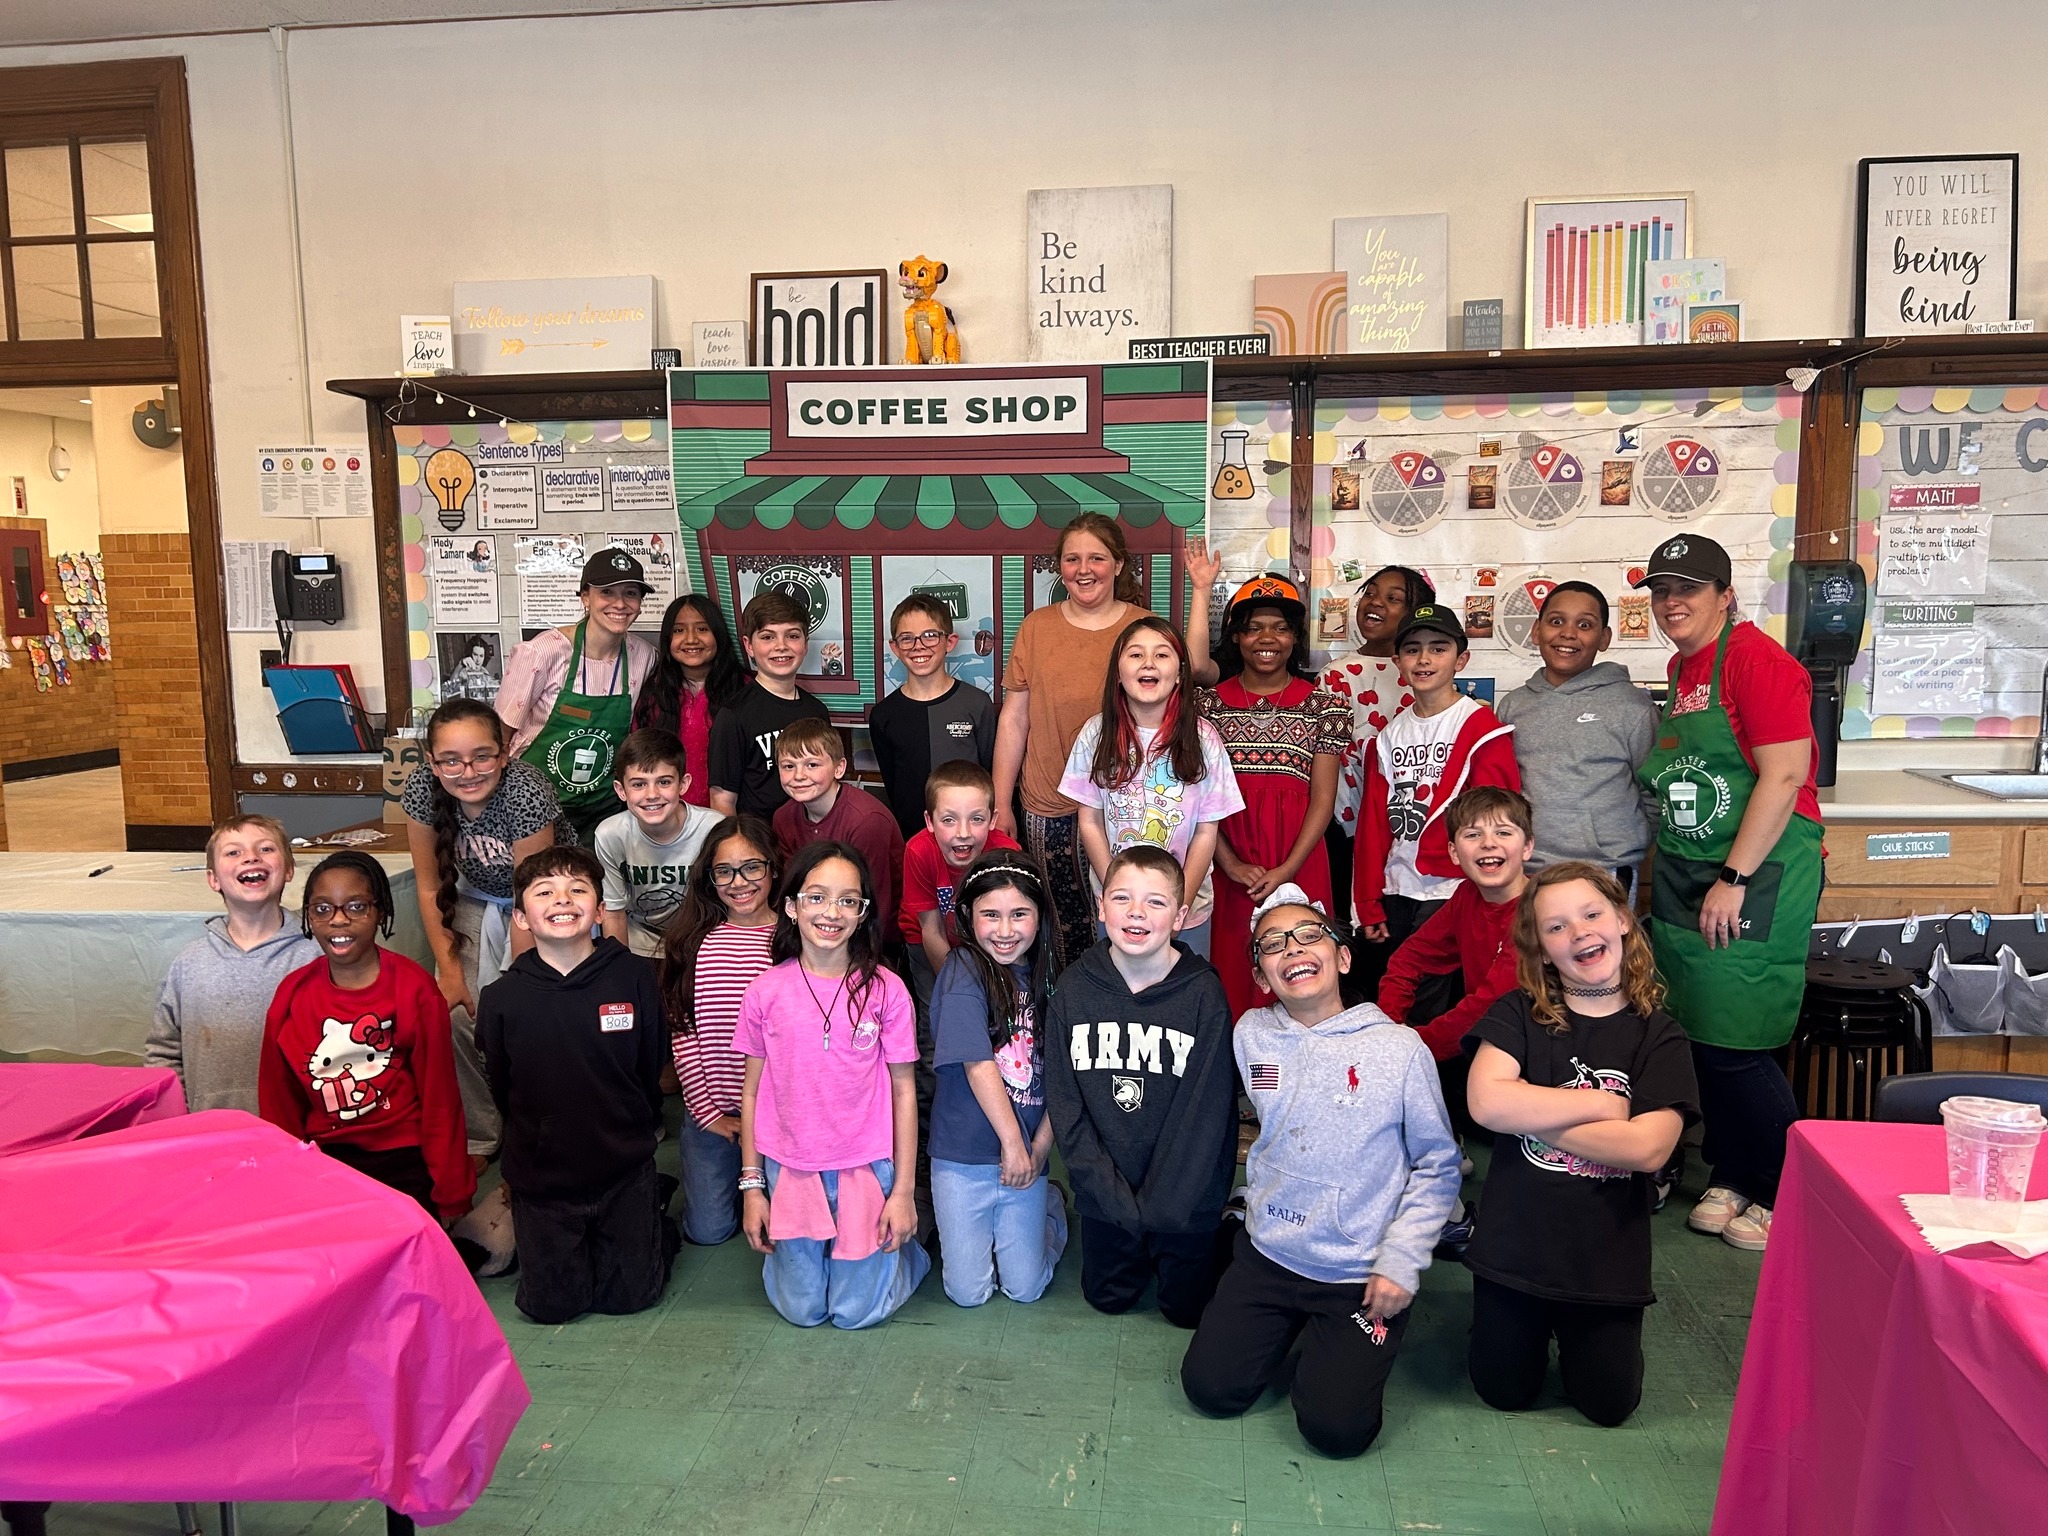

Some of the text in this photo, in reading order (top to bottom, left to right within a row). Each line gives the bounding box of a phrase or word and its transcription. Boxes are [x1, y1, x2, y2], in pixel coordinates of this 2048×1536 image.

[1893, 173, 1990, 196] YOU WILL
[1885, 207, 1997, 227] NEVER REGRET
[1041, 232, 1077, 260] Be
[1365, 228, 1400, 273] You
[1376, 261, 1395, 272] are
[1892, 236, 1987, 285] being
[1040, 264, 1107, 294] kind
[1357, 257, 1426, 294] capable
[788, 287, 806, 303] be
[1382, 283, 1394, 304] of
[1350, 300, 1428, 323] amazing
[1900, 286, 1976, 327] kind
[461, 303, 645, 334] Follow your dreams
[1039, 299, 1139, 336] always.
[702, 327, 734, 340] teach
[1702, 323, 1726, 332] BE THE
[1984, 322, 2013, 332] Teacher
[411, 331, 442, 341] TEACH
[1359, 319, 1418, 352] things
[407, 341, 444, 367] love
[707, 342, 730, 354] love
[1132, 338, 1266, 359] BEST TEACHER EVER!
[413, 361, 444, 370] inspire
[701, 357, 740, 367] inspire
[799, 395, 1077, 425] COFFEE SHOP
[478, 443, 561, 462] Sentence Types
[1900, 422, 1983, 477] WE
[545, 470, 599, 486] declarative
[611, 469, 670, 485] interrogative
[1915, 489, 1955, 504] MATH
[493, 502, 528, 510] Imperative
[494, 517, 534, 525] Exclamatory
[1950, 525, 1978, 534] model
[433, 538, 454, 549] Hedy
[1889, 540, 1899, 548] to
[440, 548, 464, 559] Lamarr
[763, 569, 818, 588] COFFEE
[1902, 606, 1958, 621] WRITING
[1902, 681, 1954, 691] of writing
[568, 728, 612, 741] COFFEE
[1666, 755, 1707, 771] COFFEE
[1667, 825, 1714, 841] COFFEE
[1881, 840, 1935, 853] GLUE STICKS
[606, 1016, 629, 1029] BOB
[1070, 1021, 1195, 1078] ARMY
[1267, 1203, 1306, 1227] RALPH
[1350, 1312, 1374, 1334] POLO
